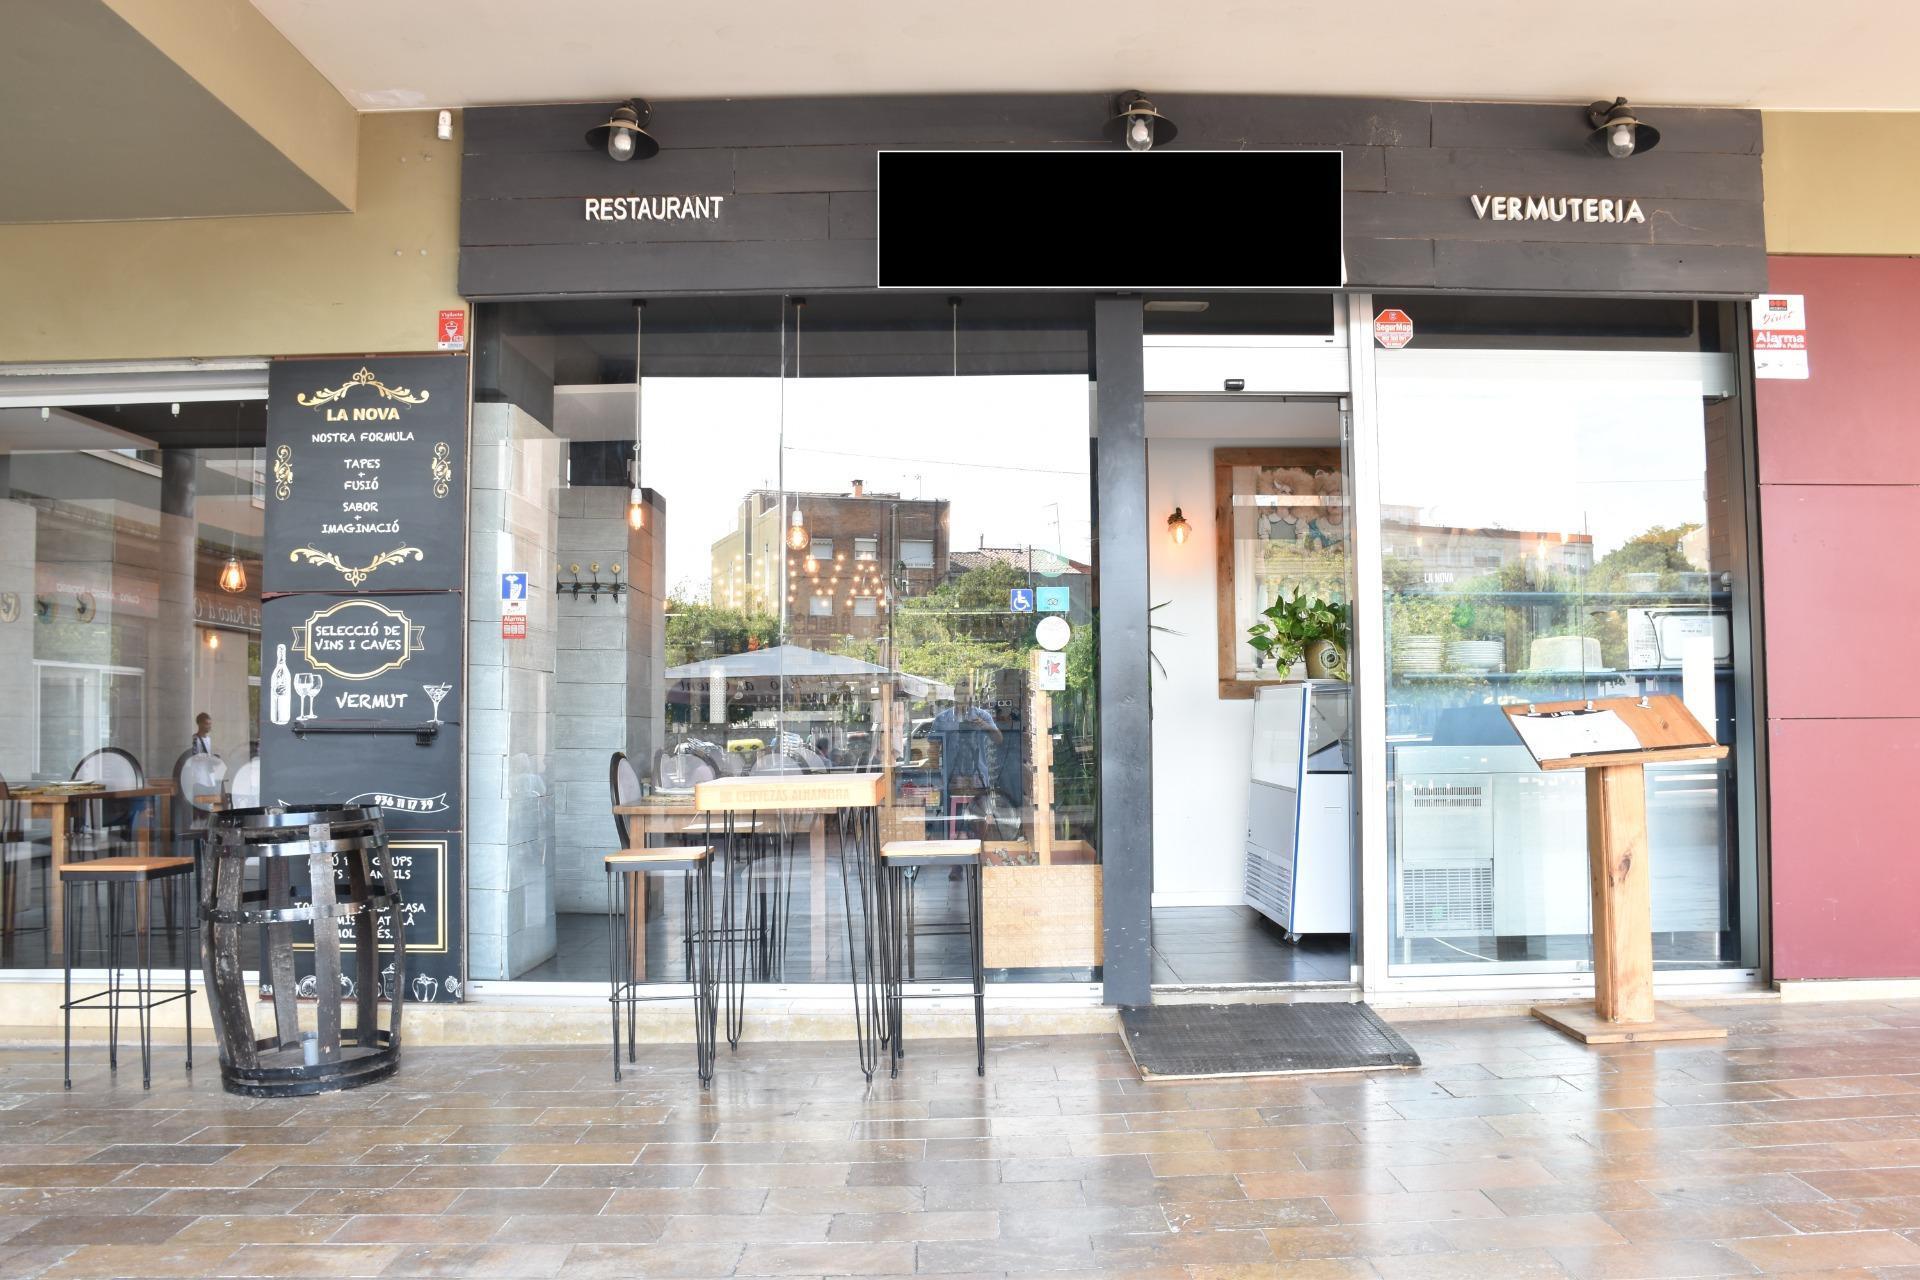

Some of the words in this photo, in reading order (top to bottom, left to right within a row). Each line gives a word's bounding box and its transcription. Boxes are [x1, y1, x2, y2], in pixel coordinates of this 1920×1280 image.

[585, 196, 723, 221] RESTAURANT
[1470, 194, 1646, 224] VERMUTERIA
[1756, 331, 1804, 343] Alarma
[327, 409, 348, 421] LA
[353, 408, 400, 421] NOVA
[311, 433, 356, 443] NOSTRA
[360, 431, 415, 443] FORMULA
[344, 459, 380, 469] TAPES
[344, 477, 379, 490] FUSIÓ
[343, 502, 379, 512] SABOR
[321, 520, 400, 534] IMAGINACIÓ
[315, 621, 379, 637] SELECCIÓ
[384, 626, 400, 636] DE
[315, 639, 343, 650] VINS
[350, 640, 356, 650] I
[361, 639, 402, 651] CAVES
[336, 692, 408, 709] VERMUT
[374, 794, 394, 807] 936
[408, 799, 418, 811] 17
[420, 799, 434, 811] 39
[372, 856, 413, 867] GUPS
